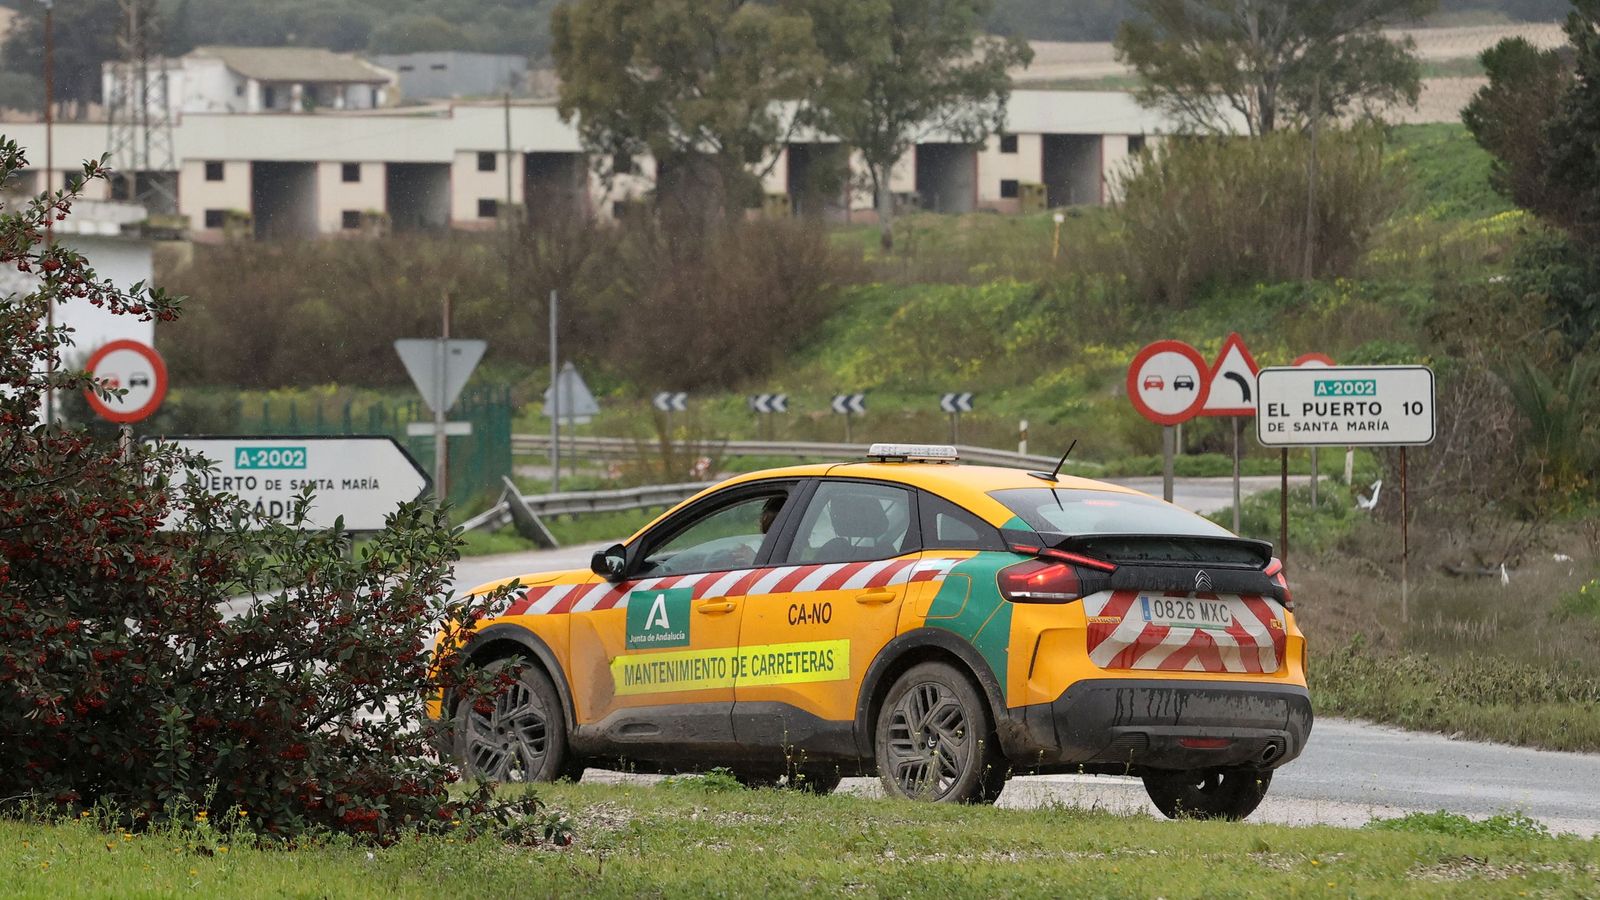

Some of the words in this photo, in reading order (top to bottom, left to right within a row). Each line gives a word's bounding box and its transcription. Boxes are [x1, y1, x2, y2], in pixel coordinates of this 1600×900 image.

[1316, 381, 1375, 395] A-2002
[1267, 402, 1290, 417] EL
[1302, 401, 1382, 417] PUERTO
[1402, 401, 1424, 416] 10
[1267, 421, 1285, 432] DE
[1293, 421, 1339, 432] SANTA
[1347, 418, 1390, 432] MARÍA
[237, 450, 305, 468] A-2002
[197, 476, 257, 491] UERTO
[265, 479, 282, 490] DE
[341, 476, 380, 490] MARÍA
[788, 602, 832, 626] CA-NO
[1154, 599, 1195, 620] 0826
[1199, 602, 1229, 623] MXC
[630, 634, 646, 643] Junta
[647, 633, 655, 642] de
[655, 630, 686, 641] Andalucía
[624, 656, 727, 687] MANTENIMIENTO
[731, 655, 748, 679] DE
[751, 649, 834, 677] CARRETERAS
